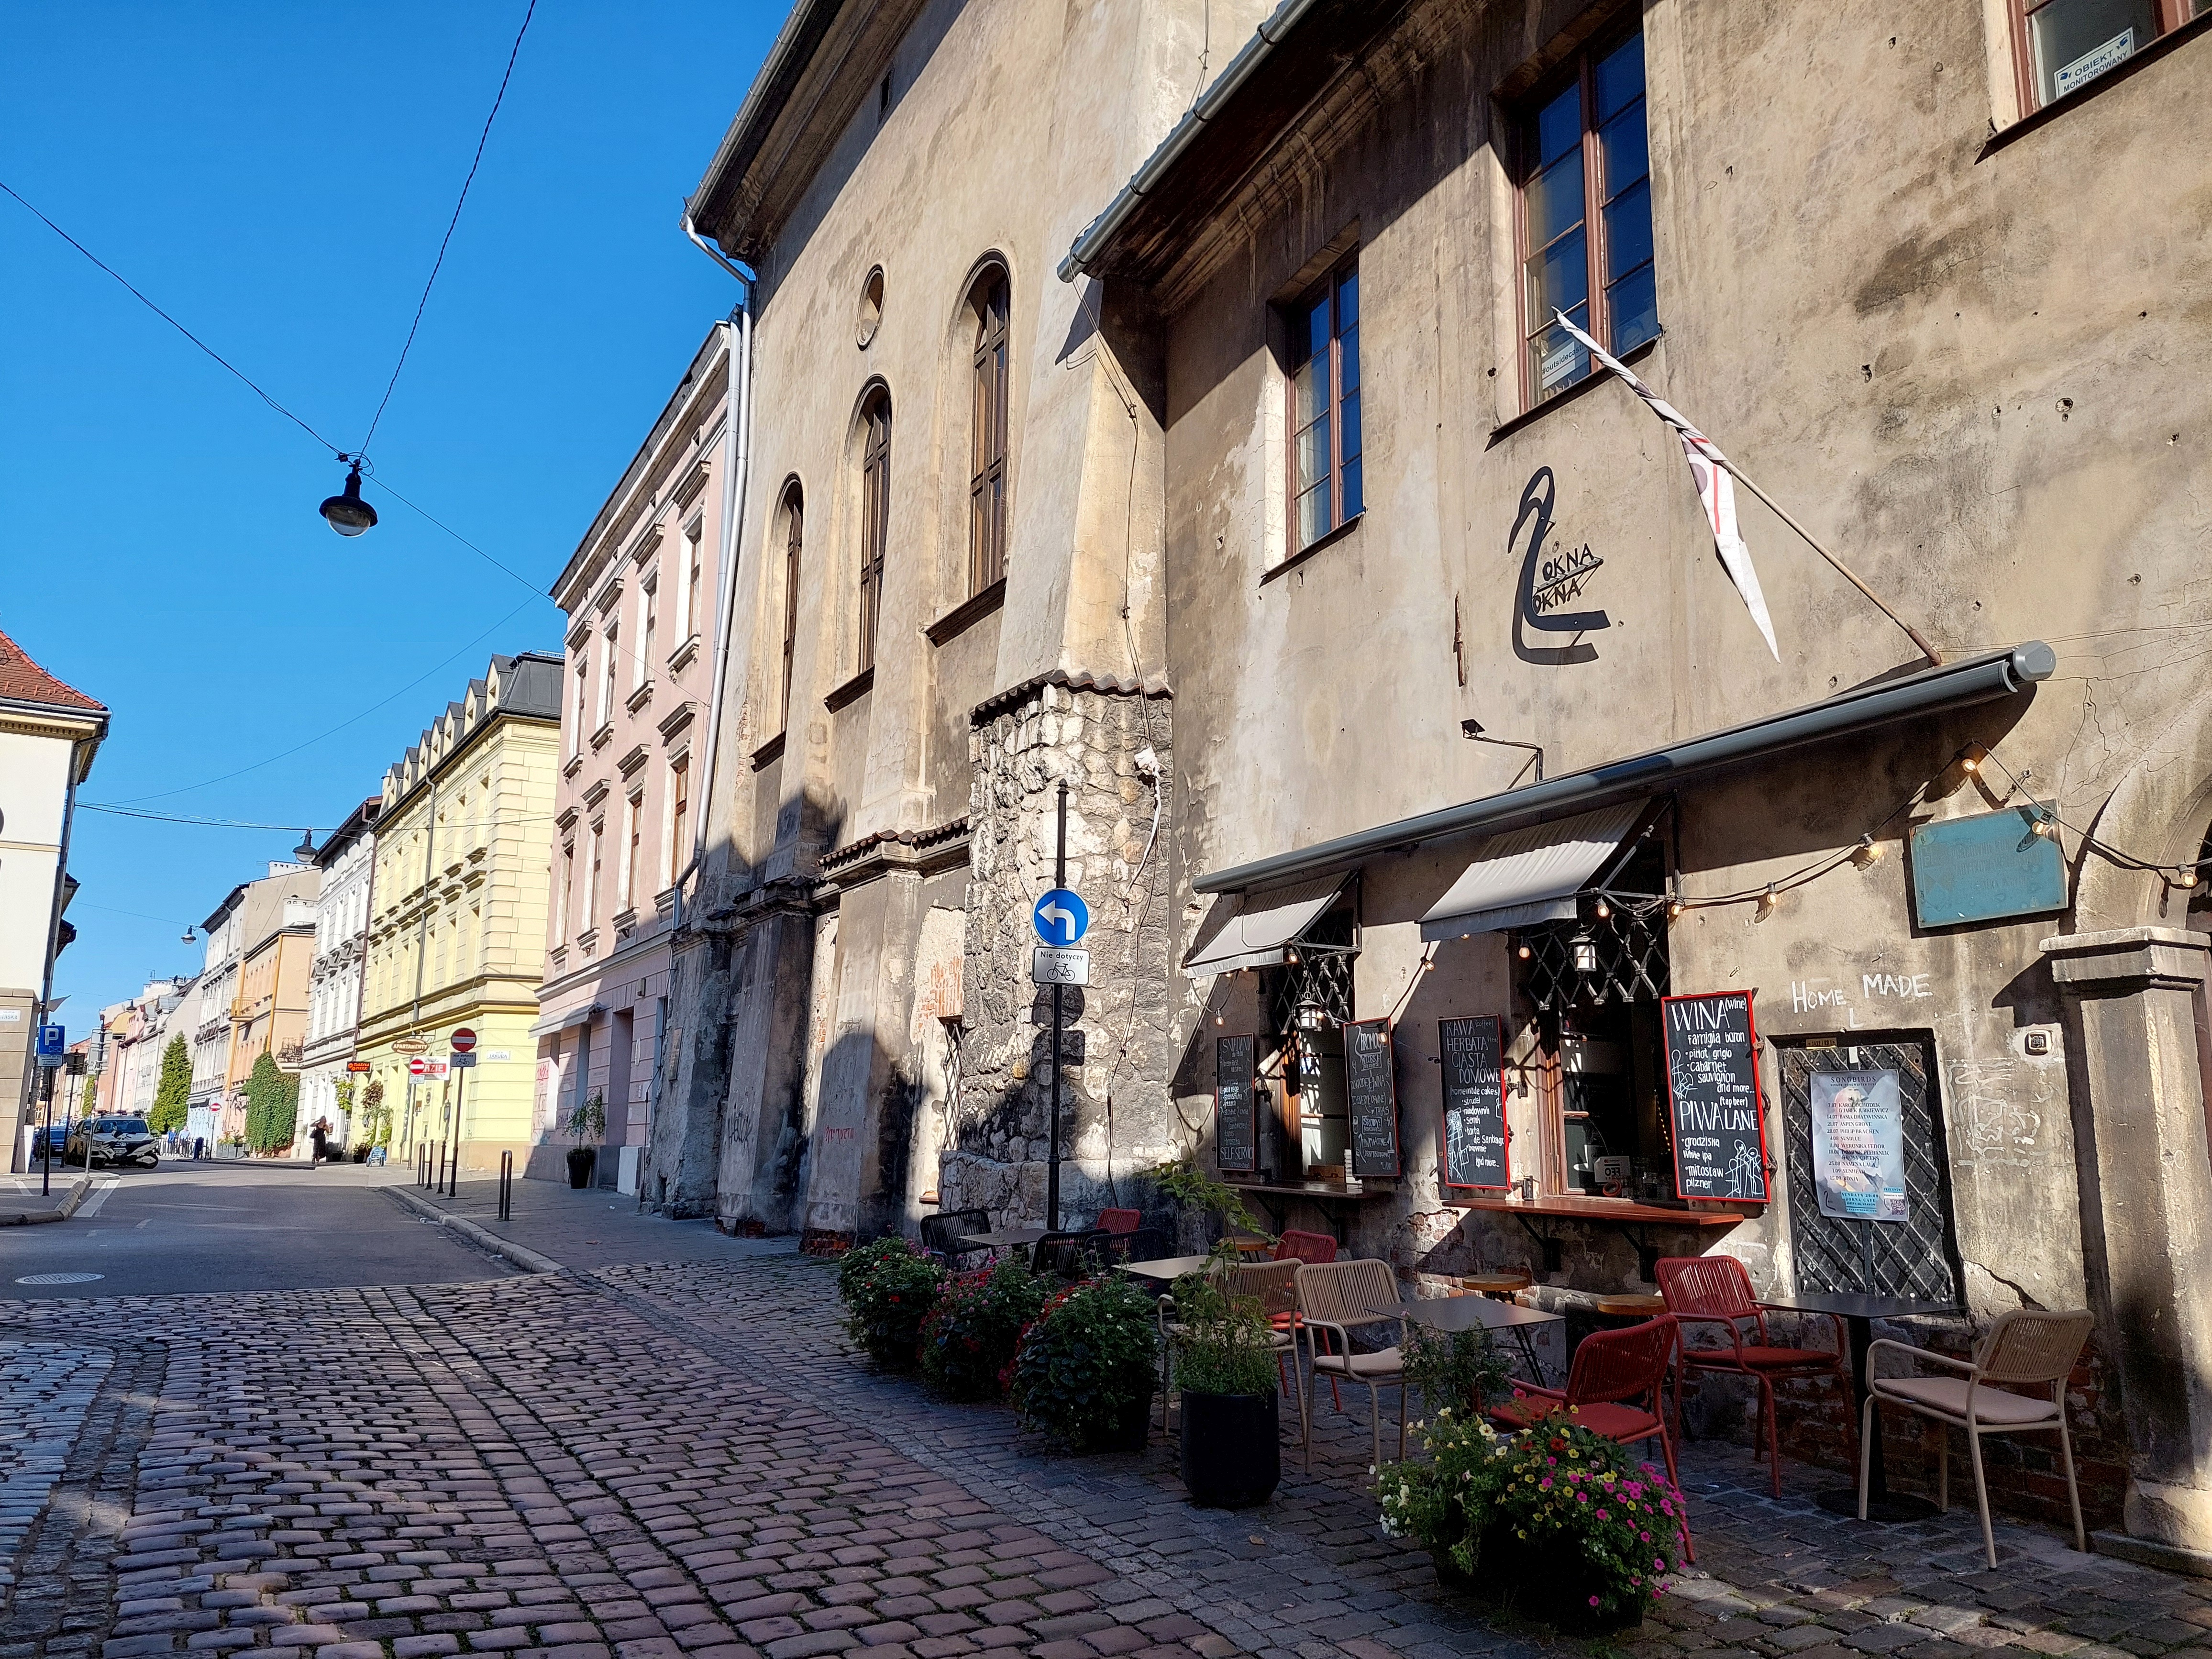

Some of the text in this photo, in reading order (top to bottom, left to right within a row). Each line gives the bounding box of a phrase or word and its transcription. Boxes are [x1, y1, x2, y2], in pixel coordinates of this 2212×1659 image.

[2063, 50, 2128, 93] MONITOROWANY
[2074, 49, 2113, 77] OBIEKT
[1542, 343, 1585, 375] #outsidecasti
[1542, 543, 1594, 581] OKNA
[1056, 952, 1083, 962] dotyczy
[1792, 973, 1934, 1014] HOME MADE
[1671, 999, 1730, 1031] WINA
[1446, 1019, 1475, 1037] KAWA
[45, 1028, 59, 1046] P
[1447, 1036, 1489, 1052] HERBATA
[1451, 1051, 1488, 1068] CIASTA
[1689, 1048, 1732, 1061] pinot grigio
[422, 1064, 444, 1072] AZIE
[1459, 1067, 1501, 1084] DOMOWE
[1698, 1071, 1736, 1086] sauvignon
[1716, 1083, 1731, 1093] and
[1463, 1095, 1481, 1106] strudel
[1733, 1096, 1748, 1107] beer)
[1374, 1106, 1390, 1116] TAPAS
[1680, 1100, 1759, 1131] PIWA LANE
[1473, 1135, 1480, 1144] de
[1220, 1146, 1235, 1161] SELF
[1686, 1177, 1713, 1194] pilzner
